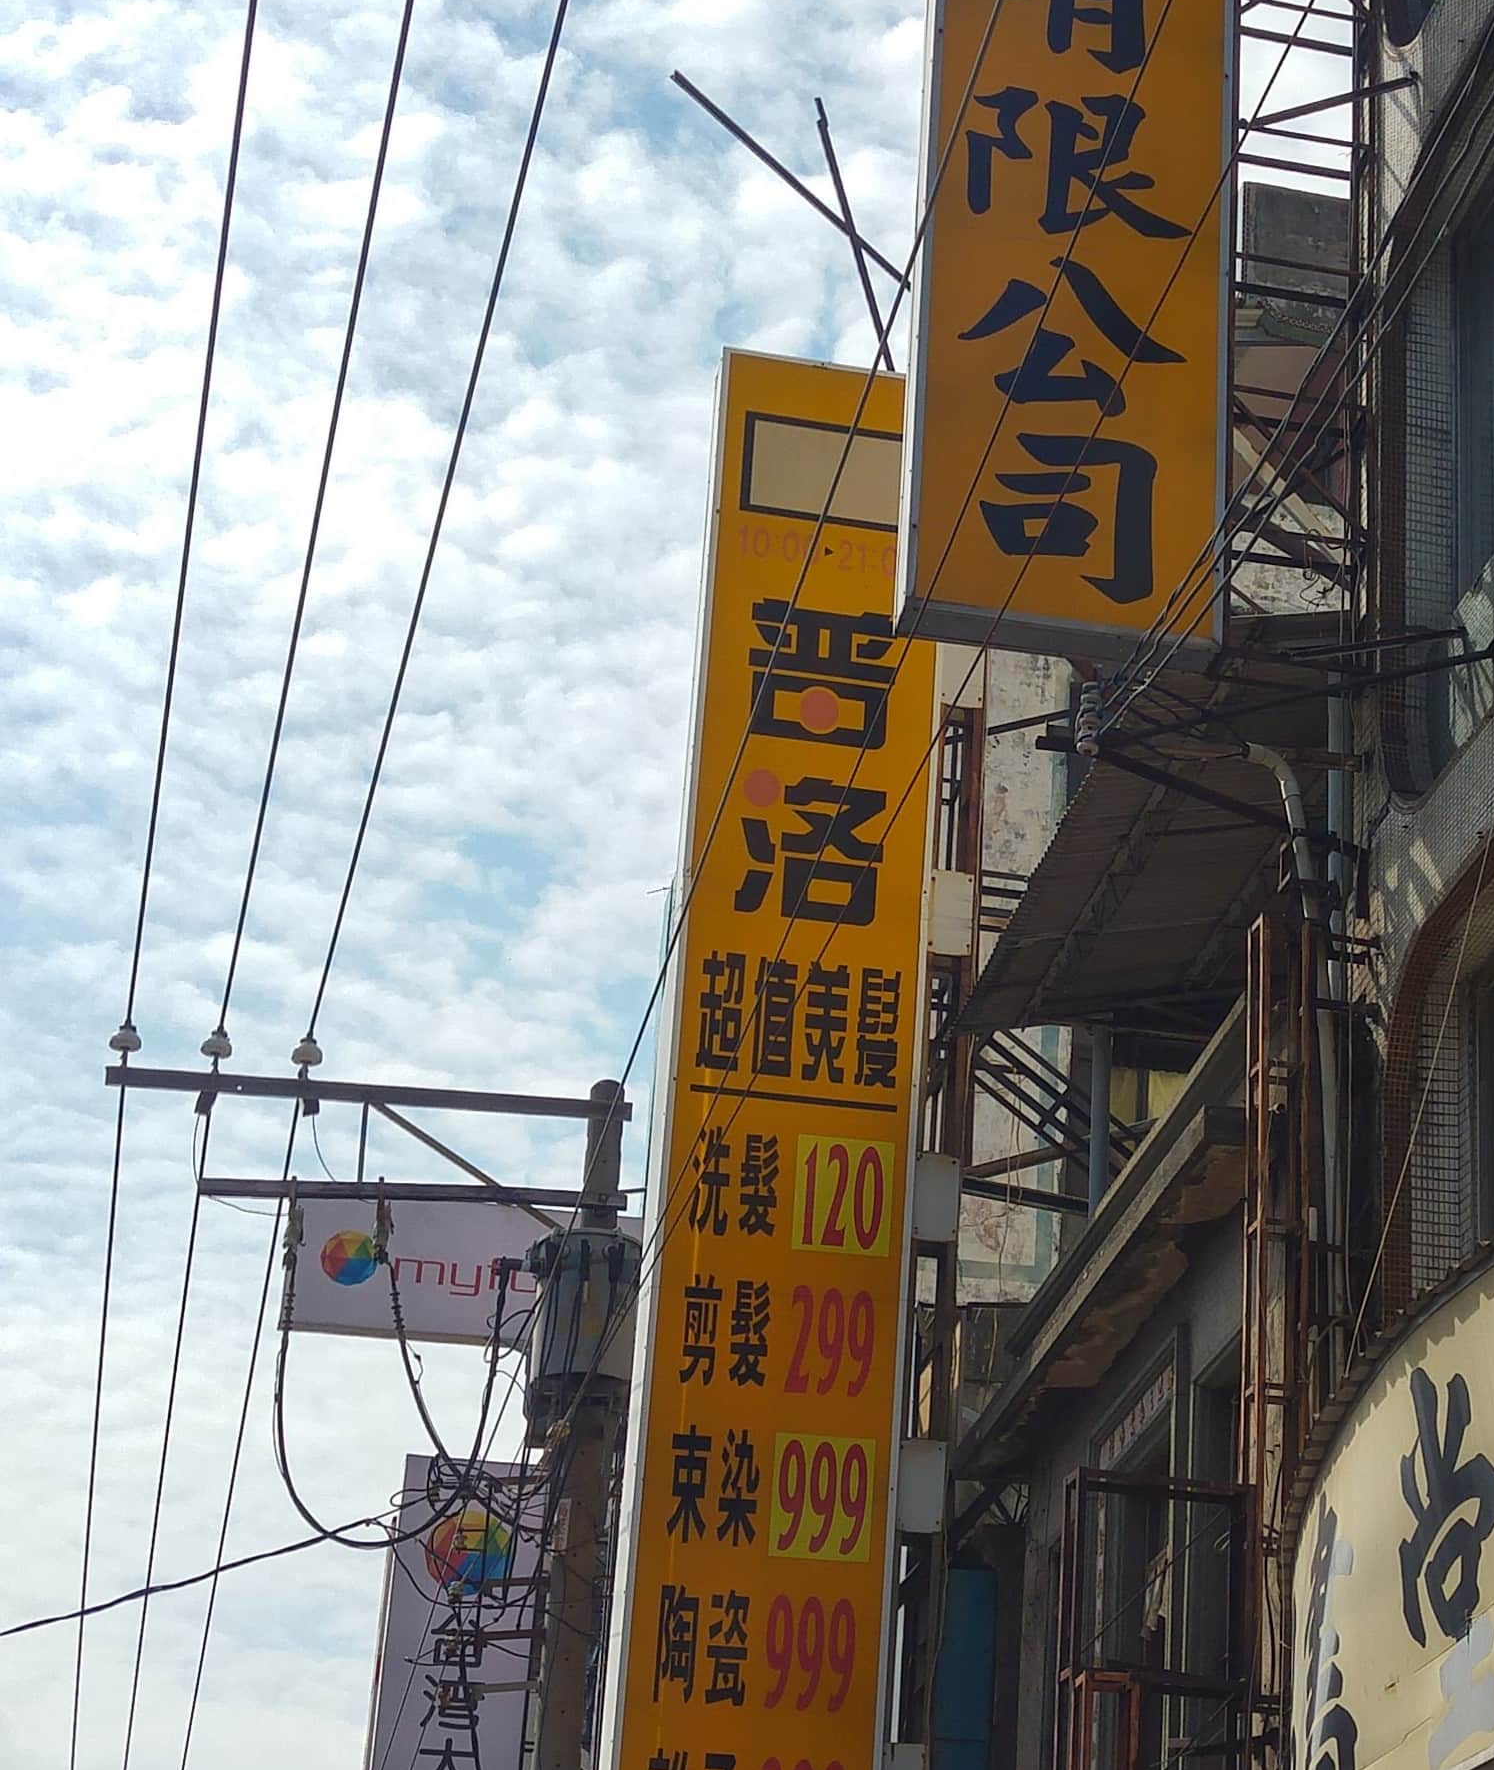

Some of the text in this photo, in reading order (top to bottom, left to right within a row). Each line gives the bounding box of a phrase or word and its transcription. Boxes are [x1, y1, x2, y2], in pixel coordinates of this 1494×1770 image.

[694, 949, 902, 1089] 超值美髮
[687, 1125, 884, 1251] 洗髮 120
[678, 1274, 876, 1399] 剪髮 299
[776, 1436, 868, 1556] 999
[652, 1583, 856, 1715] 陶瓷 999
